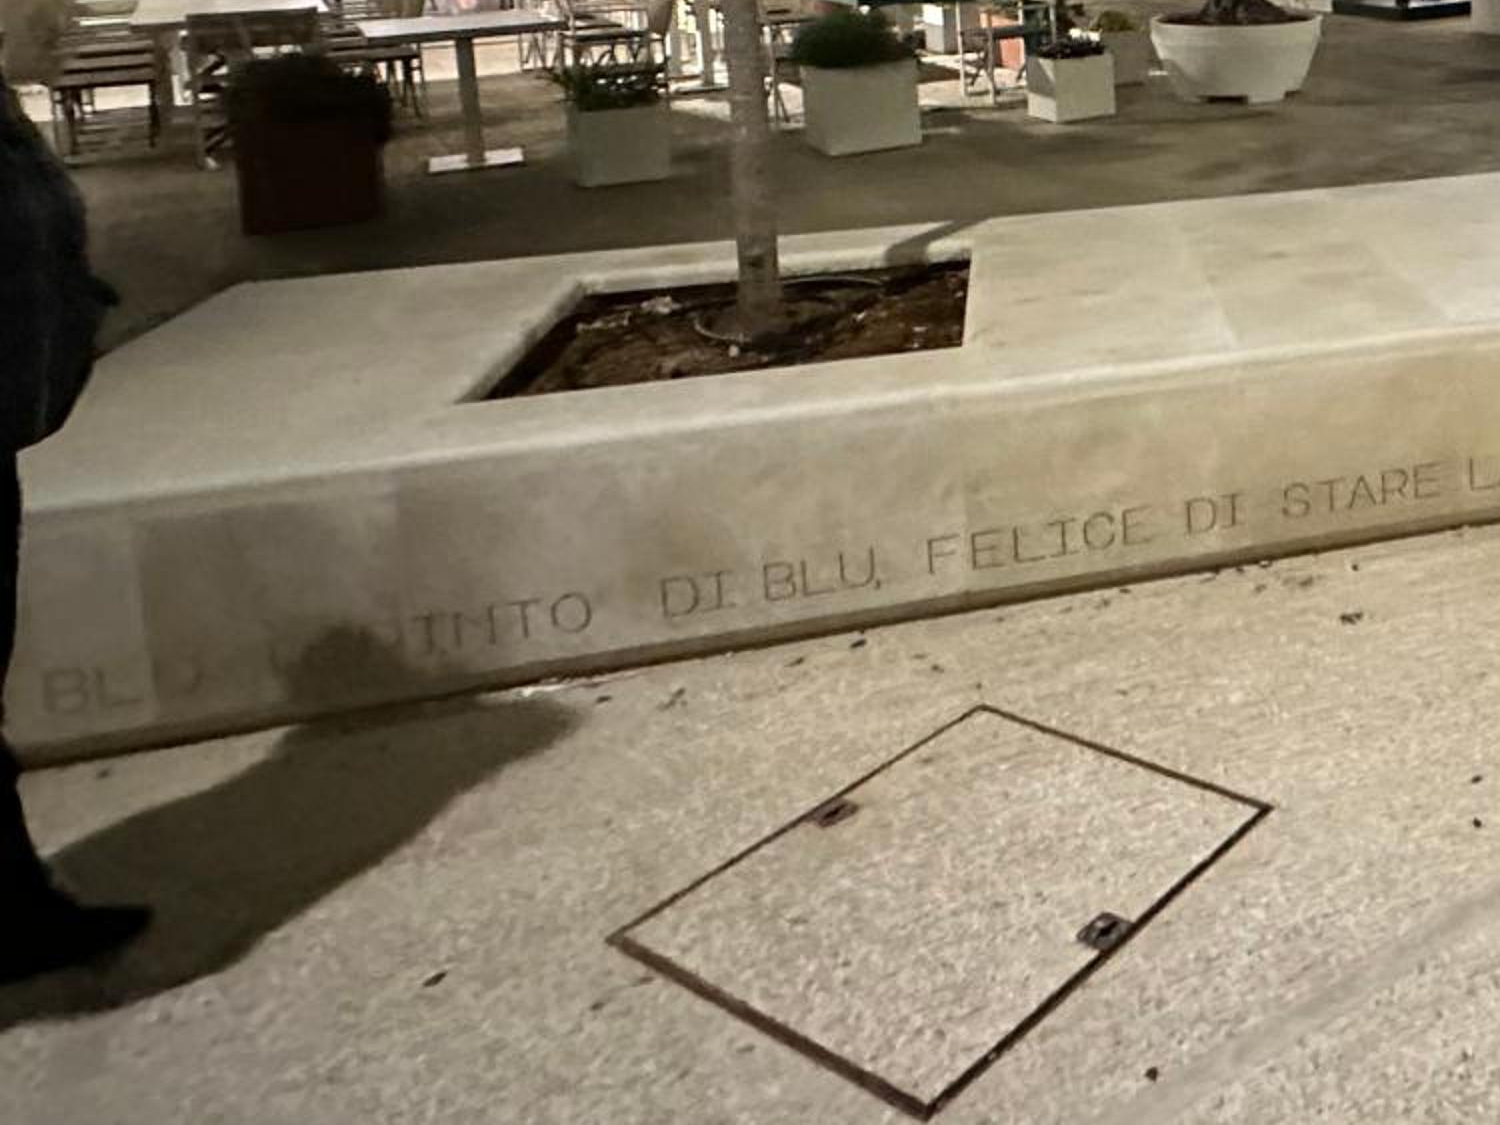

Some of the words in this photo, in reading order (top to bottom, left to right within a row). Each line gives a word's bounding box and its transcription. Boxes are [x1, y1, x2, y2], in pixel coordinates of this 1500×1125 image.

[661, 570, 737, 618] DI
[761, 547, 884, 603] BLU,
[926, 505, 1153, 574] FELICE
[1184, 492, 1243, 536] DI
[1281, 461, 1441, 519] STARE
